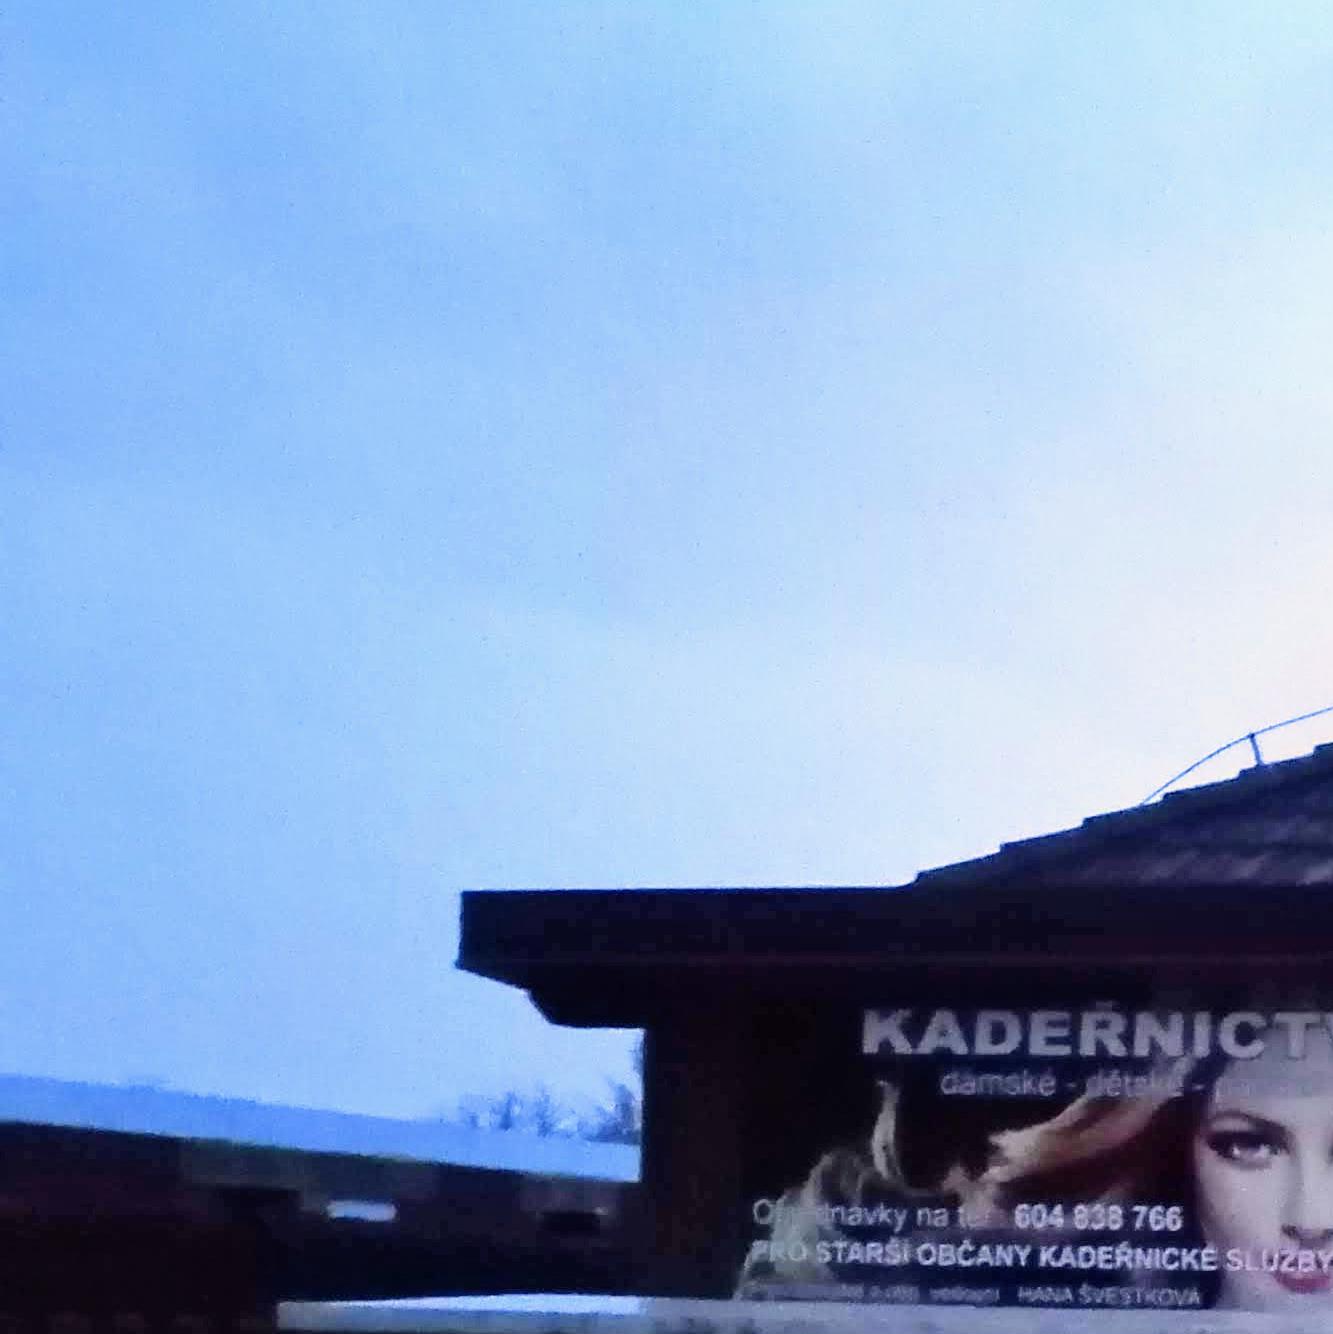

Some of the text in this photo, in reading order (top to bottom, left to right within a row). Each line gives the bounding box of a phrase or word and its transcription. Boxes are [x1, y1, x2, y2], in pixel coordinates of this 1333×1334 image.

[917, 1206, 949, 1227] na
[1014, 1203, 1064, 1229] 604
[1073, 1204, 1123, 1230] 838
[1132, 1205, 1183, 1231] 766
[751, 1240, 807, 1263] PRO
[916, 1239, 1032, 1268] OBČANY
[1039, 1241, 1217, 1271] KADEŘNICKÉ
